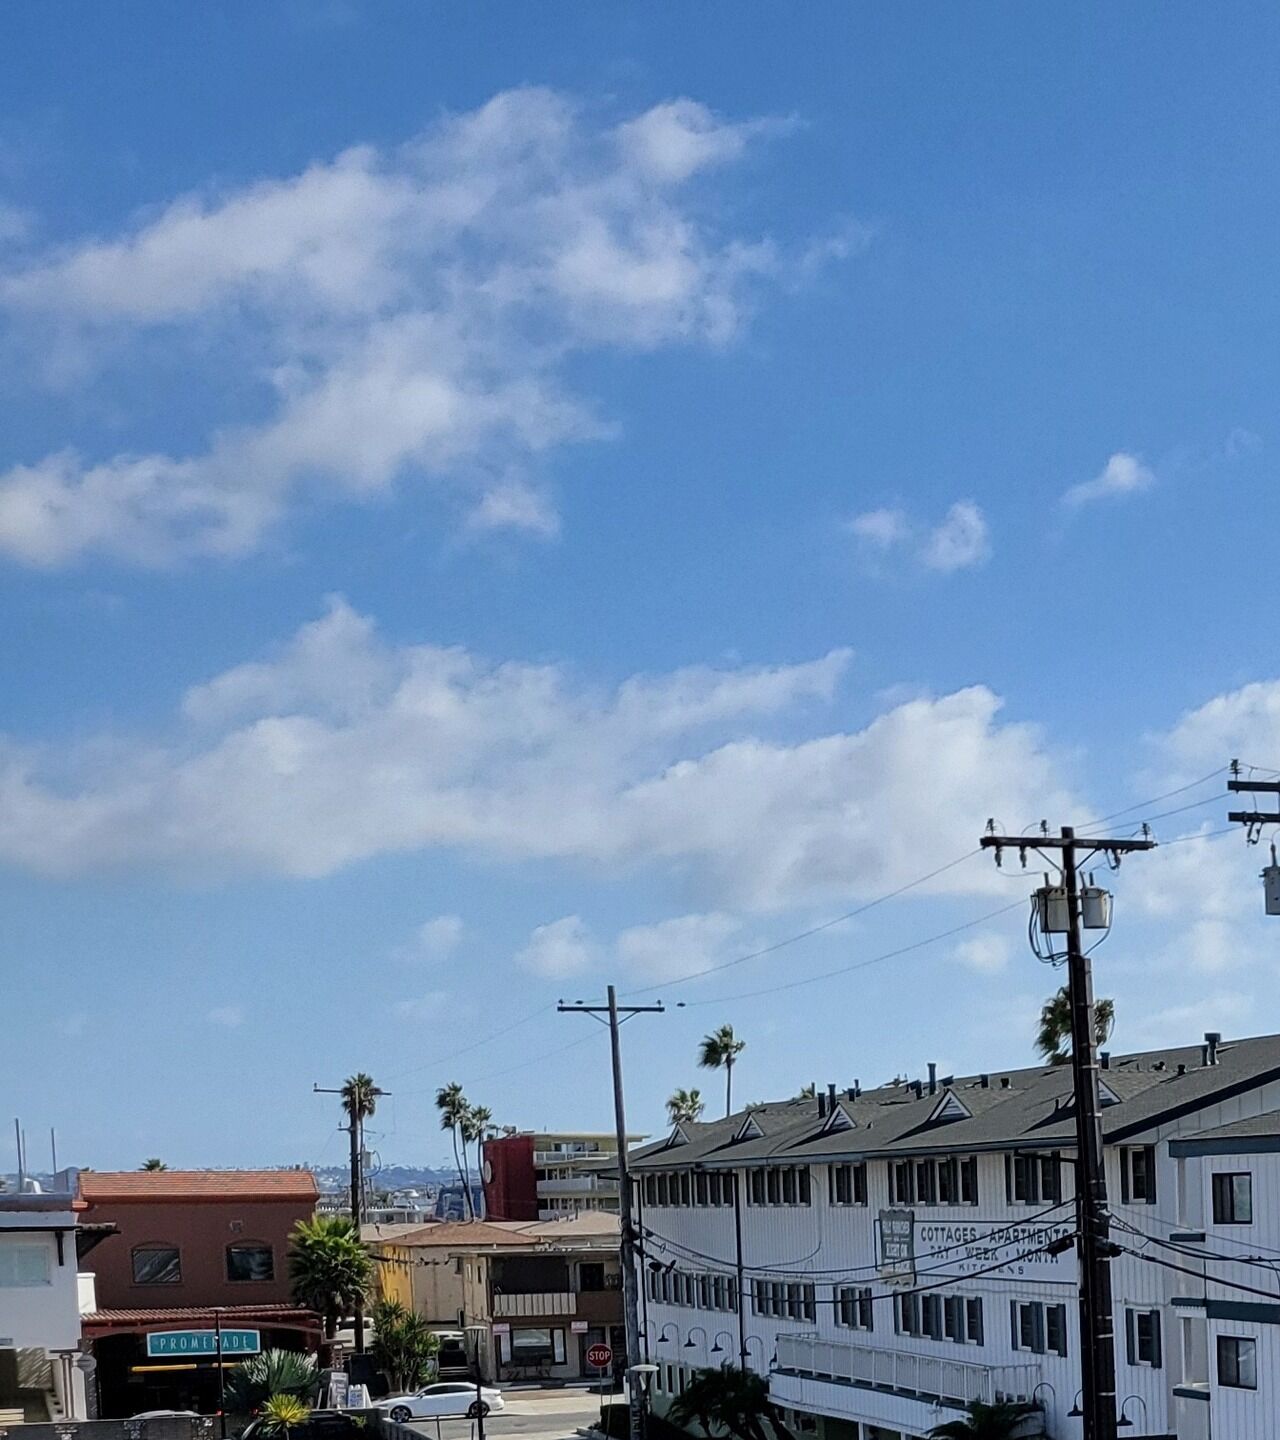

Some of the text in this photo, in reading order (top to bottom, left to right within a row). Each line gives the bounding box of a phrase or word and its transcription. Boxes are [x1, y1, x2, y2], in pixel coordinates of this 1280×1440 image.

[920, 1226, 977, 1242] COTTAGES
[965, 1246, 998, 1261] WEEK
[960, 1263, 1024, 1275] KITCENS
[160, 1336, 249, 1350] PROMENADE
[589, 1351, 611, 1361] STOP
